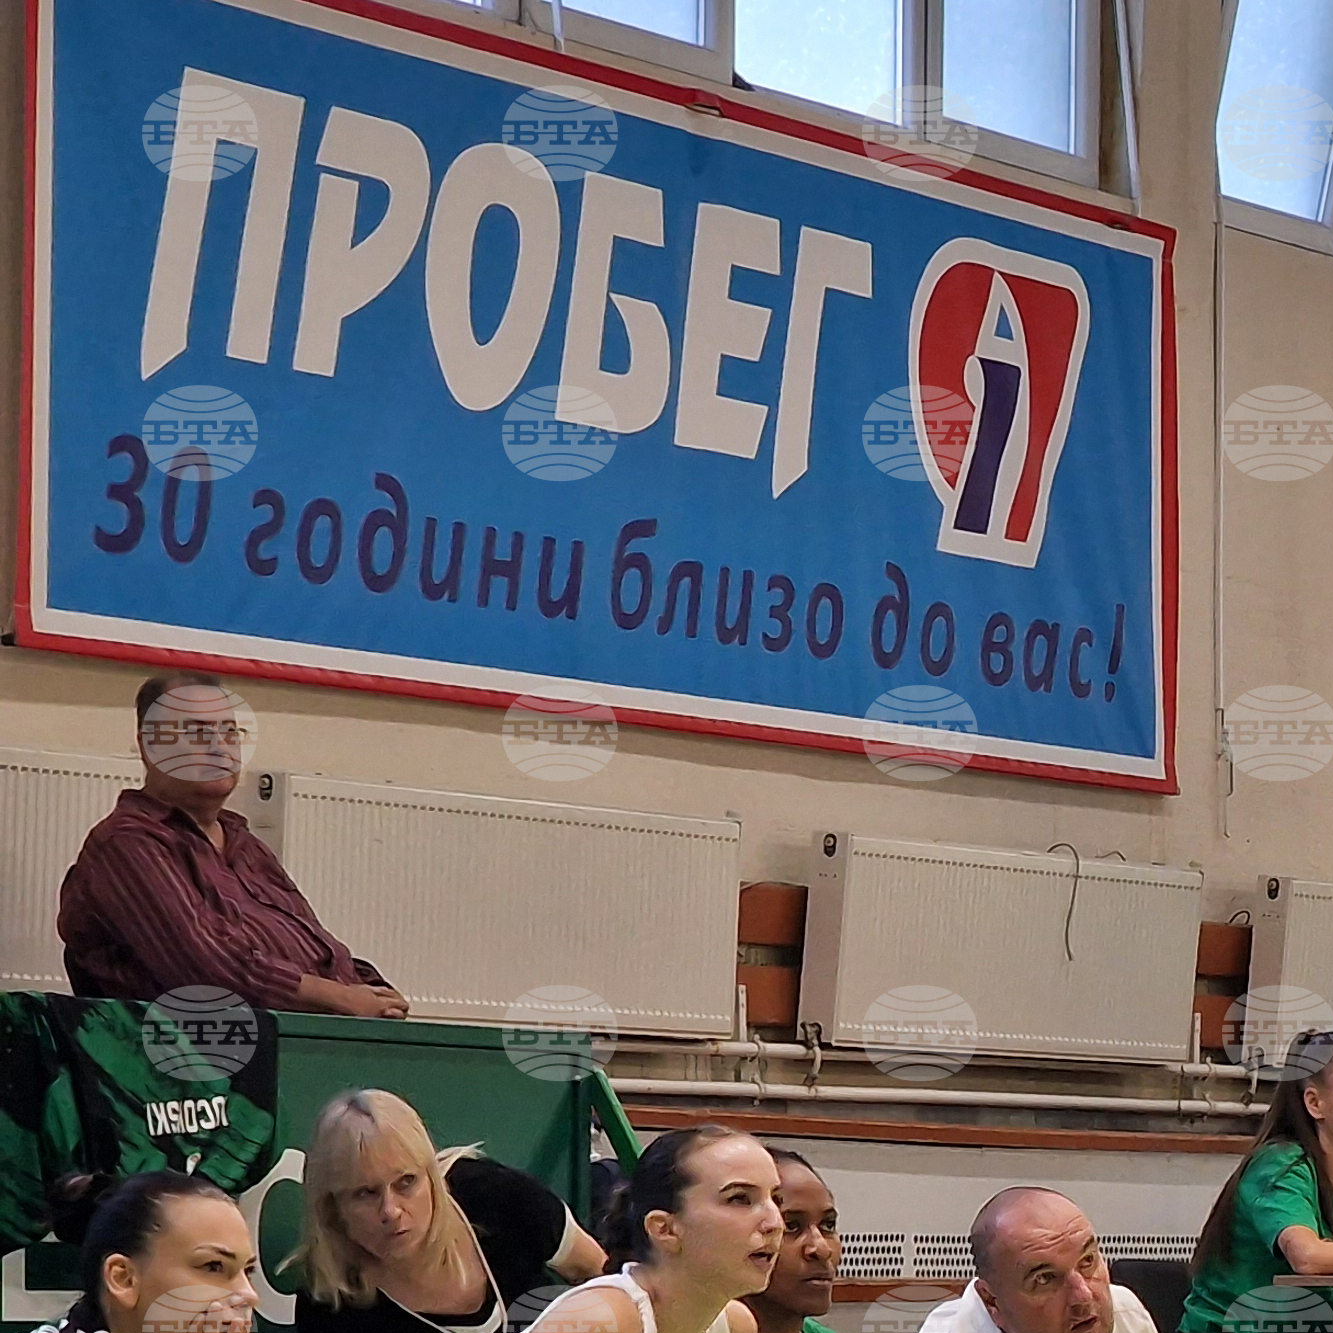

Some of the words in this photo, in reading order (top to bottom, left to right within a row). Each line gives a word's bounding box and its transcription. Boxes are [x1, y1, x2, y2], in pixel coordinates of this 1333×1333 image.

[141, 67, 872, 499] ПРОБЕГ
[94, 434, 212, 563] 30
[245, 473, 584, 620] години
[610, 518, 843, 659] близо
[871, 561, 955, 676] до
[981, 603, 1125, 702] вас!
